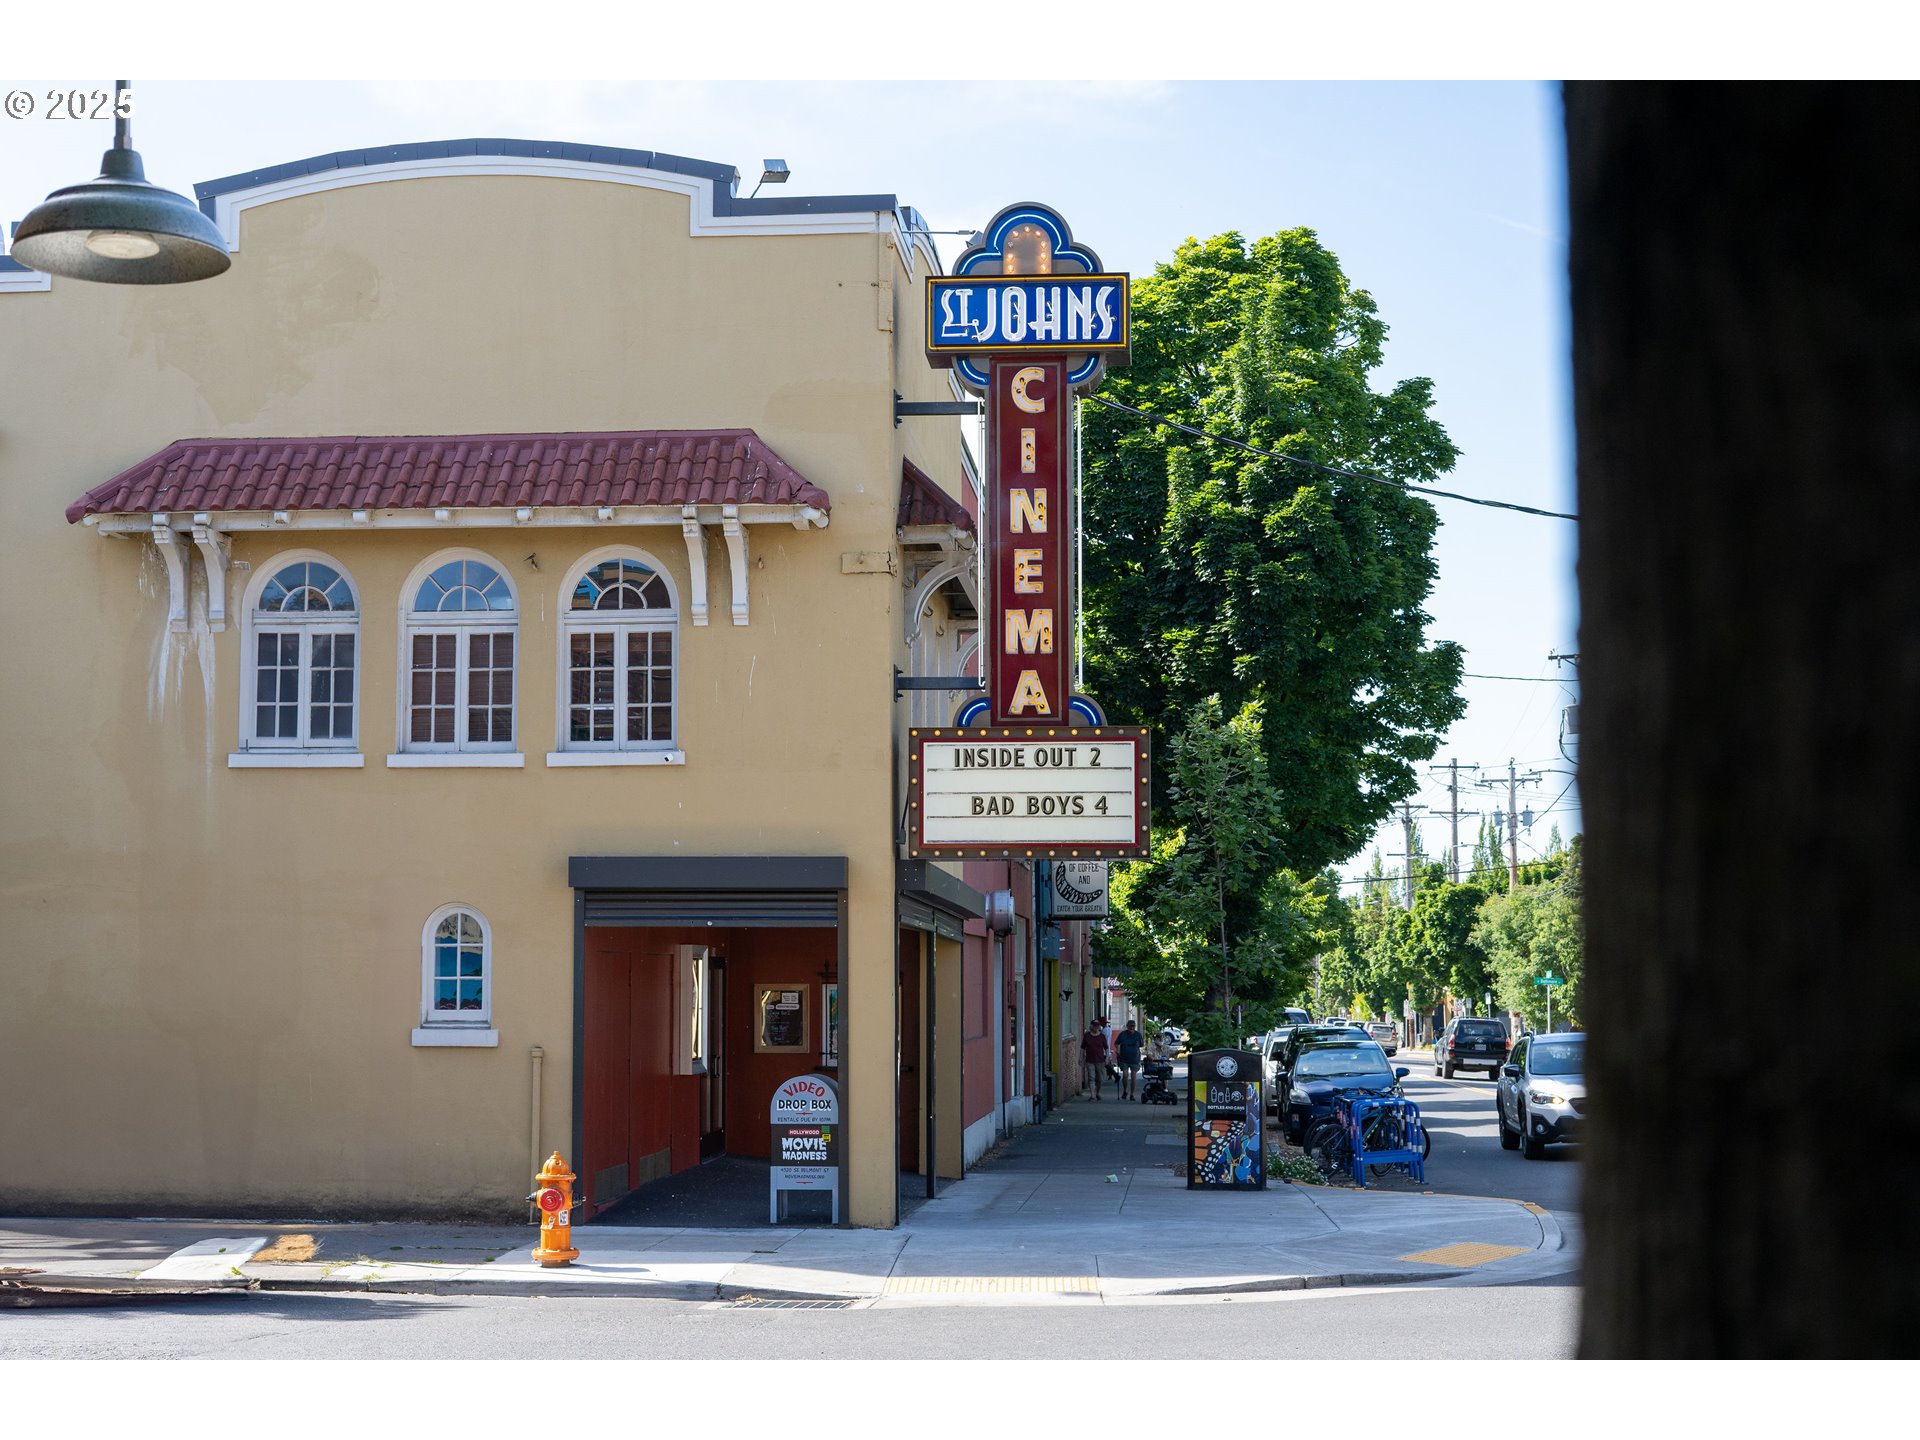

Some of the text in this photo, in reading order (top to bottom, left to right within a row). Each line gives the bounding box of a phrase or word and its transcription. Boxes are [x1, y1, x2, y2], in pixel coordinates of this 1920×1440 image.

[974, 286, 1114, 342] JOHNS
[1005, 367, 1053, 715] CINEMA
[954, 747, 1101, 768] INSIDE OUT 2
[971, 795, 1108, 815] BAD BOYS 4
[1068, 863, 1100, 873] OF COFFEE
[1078, 875, 1091, 885] AND
[783, 1081, 825, 1097] VIDEO
[777, 1099, 832, 1111] DROP BOX
[781, 1137, 827, 1151] MOVIE
[782, 1151, 827, 1161] MADNESS
